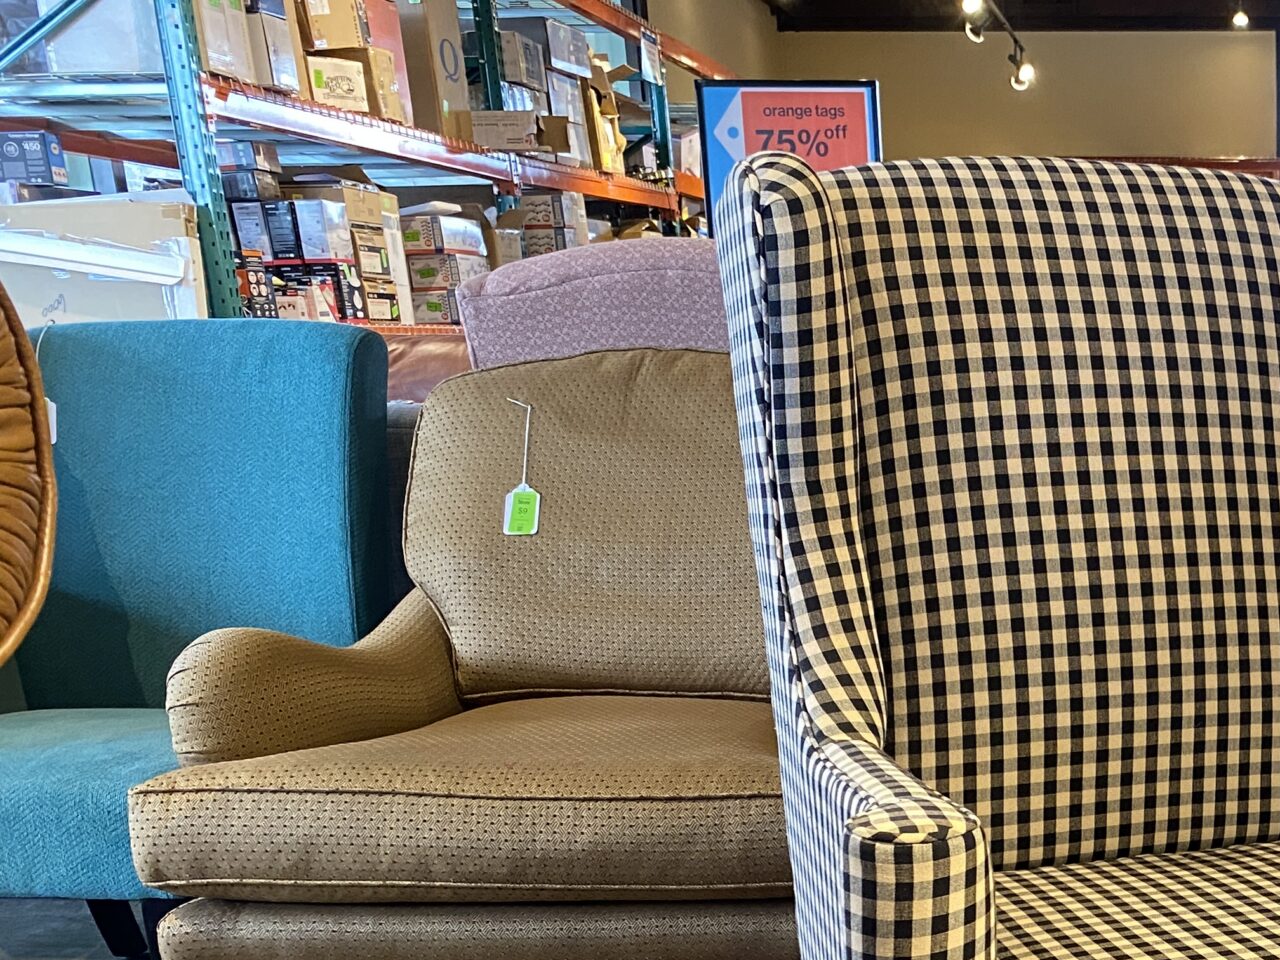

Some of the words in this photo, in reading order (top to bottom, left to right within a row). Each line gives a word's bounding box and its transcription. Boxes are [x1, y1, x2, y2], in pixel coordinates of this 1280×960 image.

[439, 38, 459, 83] Q
[763, 105, 812, 119] orange
[815, 104, 845, 119] tags
[755, 128, 829, 157] 75%
[824, 124, 848, 139] off
